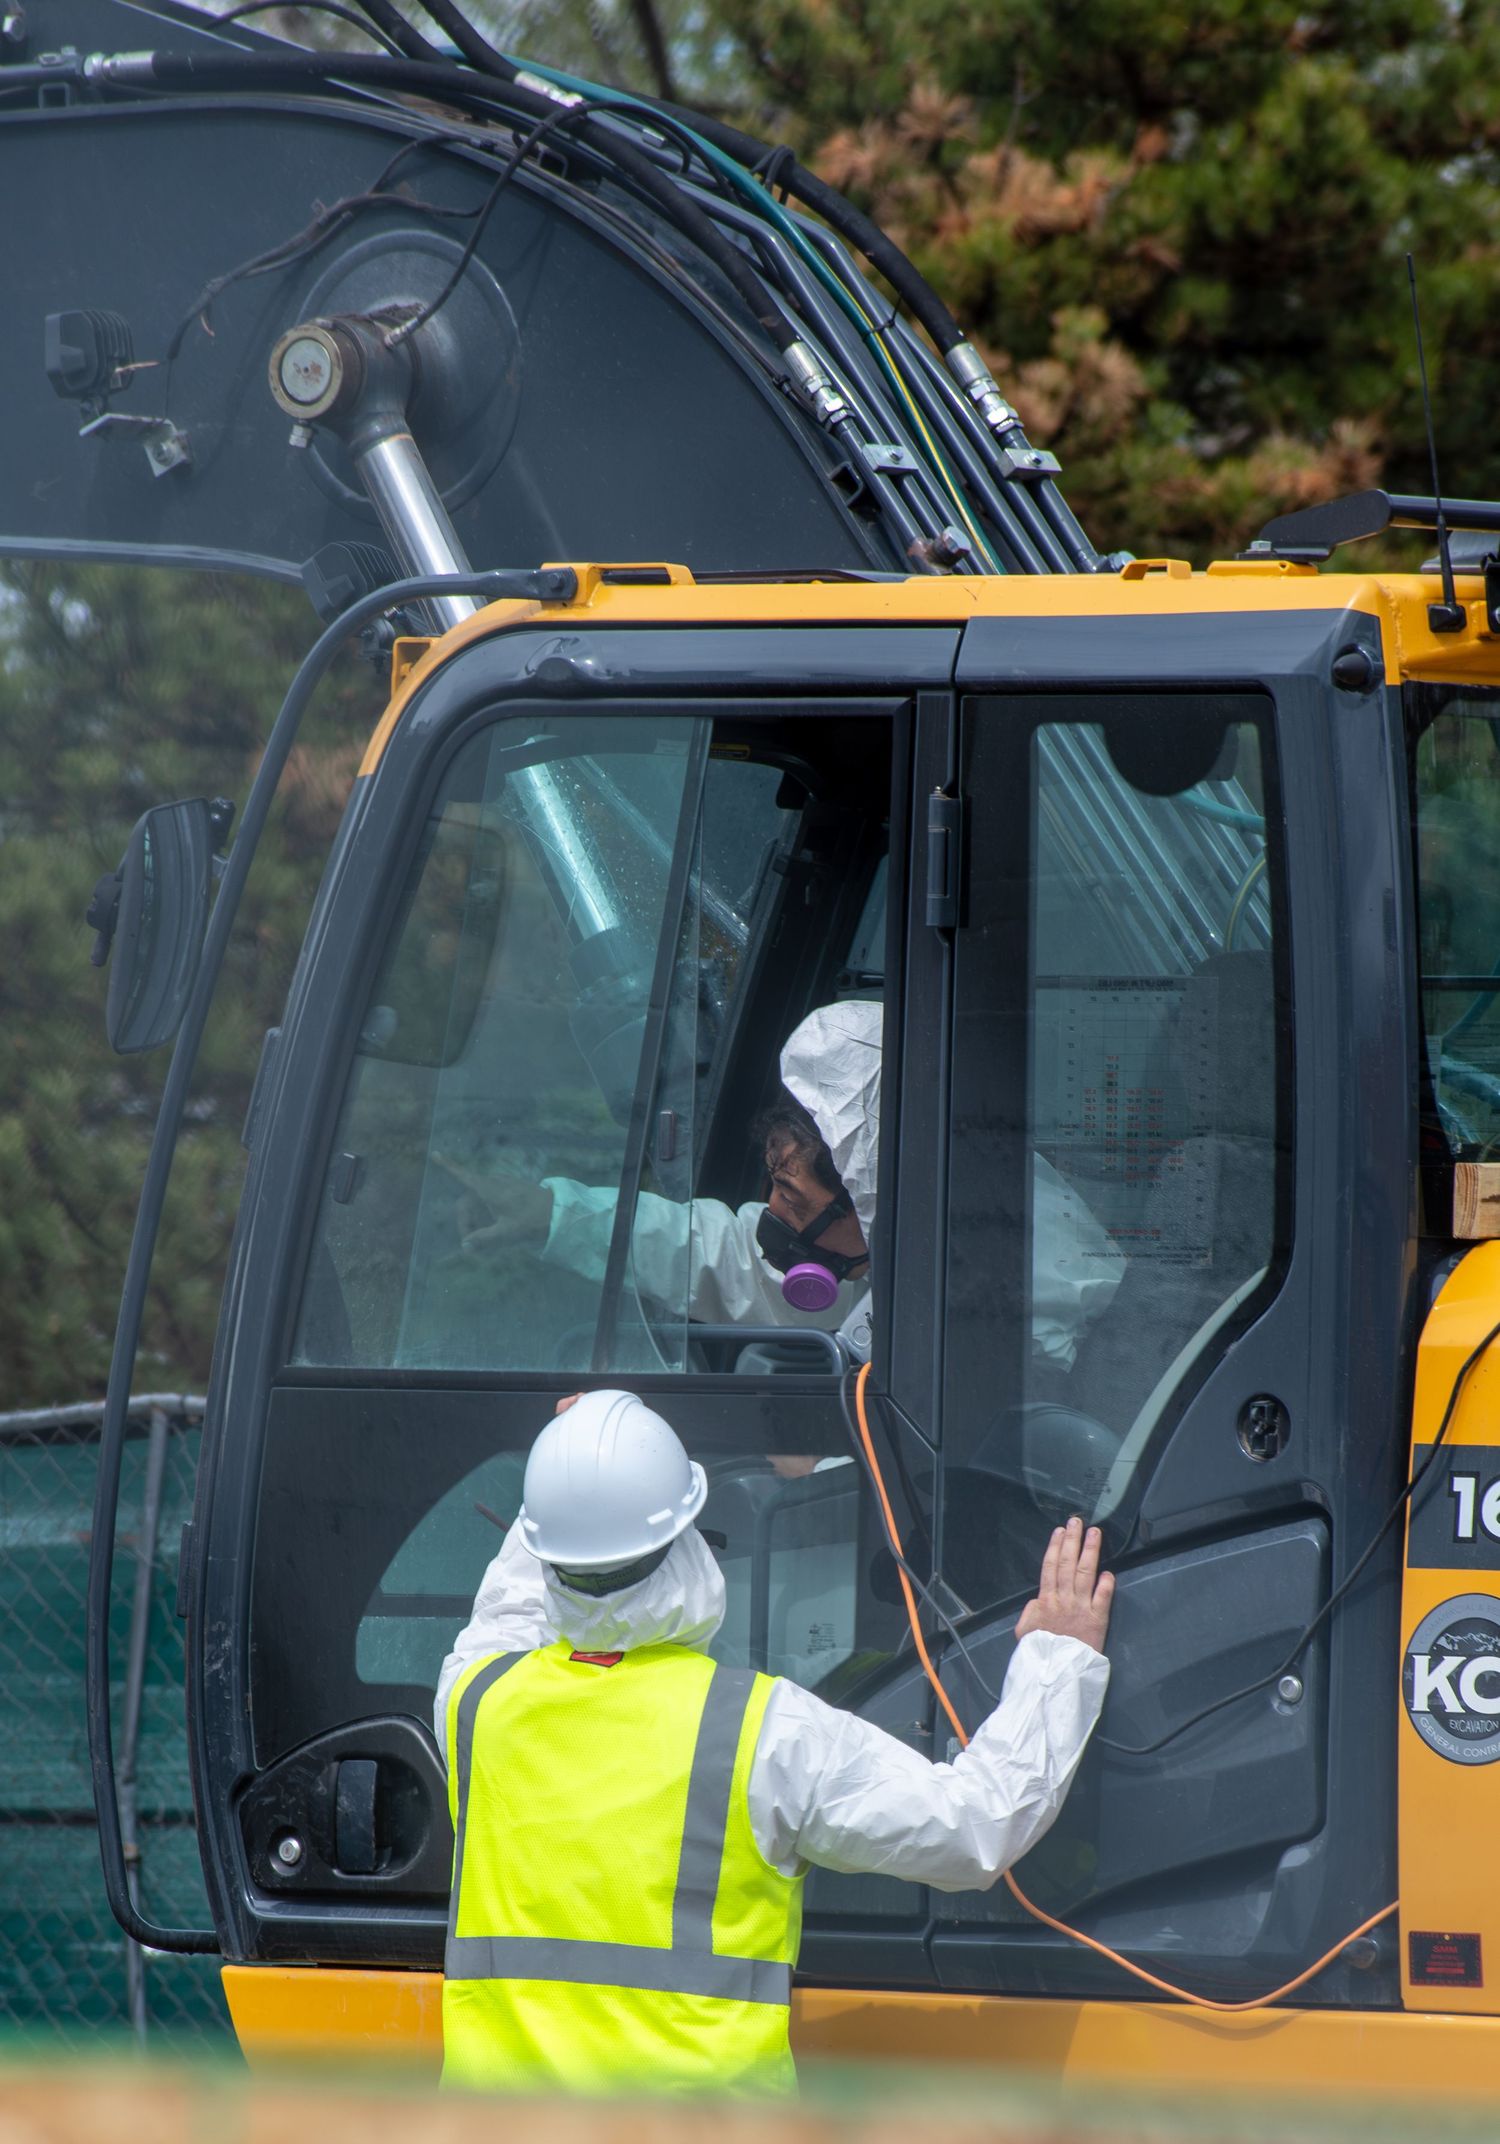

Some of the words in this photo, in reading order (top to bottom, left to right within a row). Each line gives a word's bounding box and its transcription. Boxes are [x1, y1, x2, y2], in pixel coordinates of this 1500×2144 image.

[1420, 1717, 1461, 1755] GENERAL
[1463, 1742, 1500, 1757] CONTR
[1449, 1719, 1499, 1733] EXCAVATION
